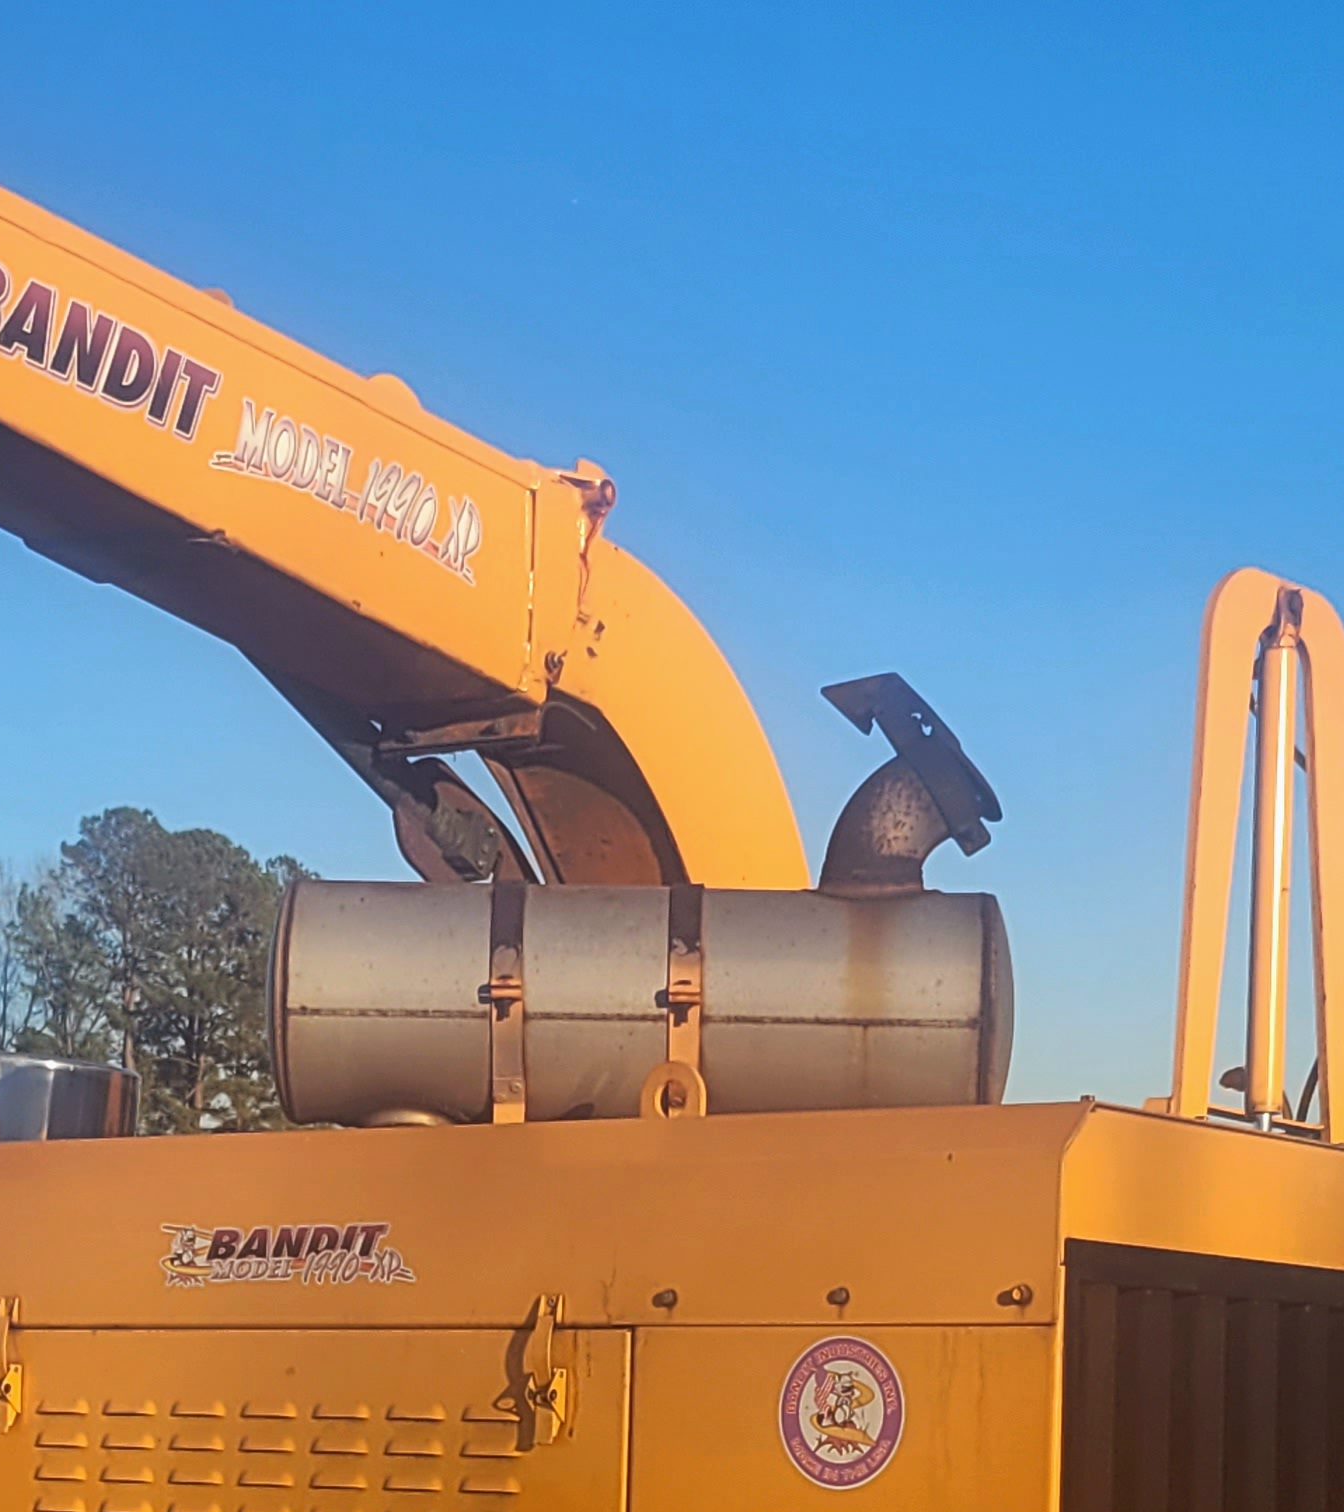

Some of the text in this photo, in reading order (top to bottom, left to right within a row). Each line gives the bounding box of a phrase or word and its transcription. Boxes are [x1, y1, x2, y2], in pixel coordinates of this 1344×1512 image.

[230, 399, 357, 511] MODEL
[356, 456, 437, 548] 1990
[206, 1224, 390, 1260] BANDIT
[210, 1249, 402, 1284] MODEL 1990 XP
